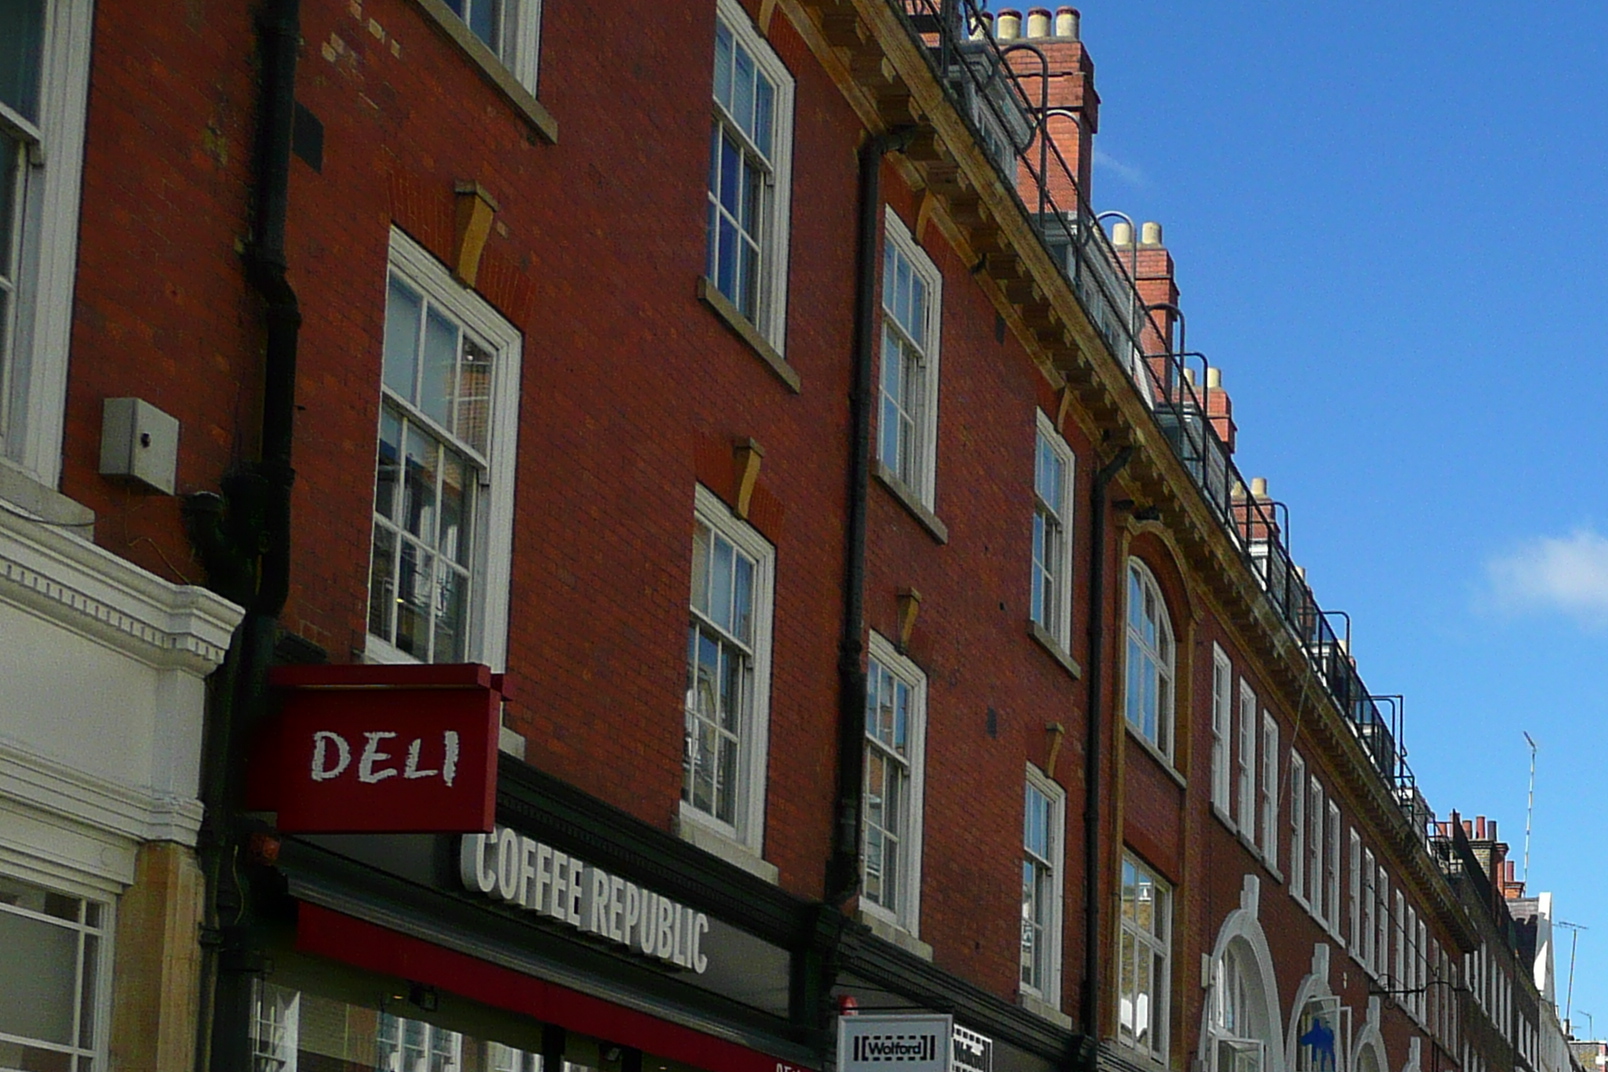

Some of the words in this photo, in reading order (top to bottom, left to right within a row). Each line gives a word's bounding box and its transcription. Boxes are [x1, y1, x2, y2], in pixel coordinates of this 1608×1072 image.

[311, 730, 459, 787] DELI
[464, 826, 585, 927] COFFEE
[588, 867, 709, 974] REPUBLIC
[868, 1041, 922, 1055] Wolford
